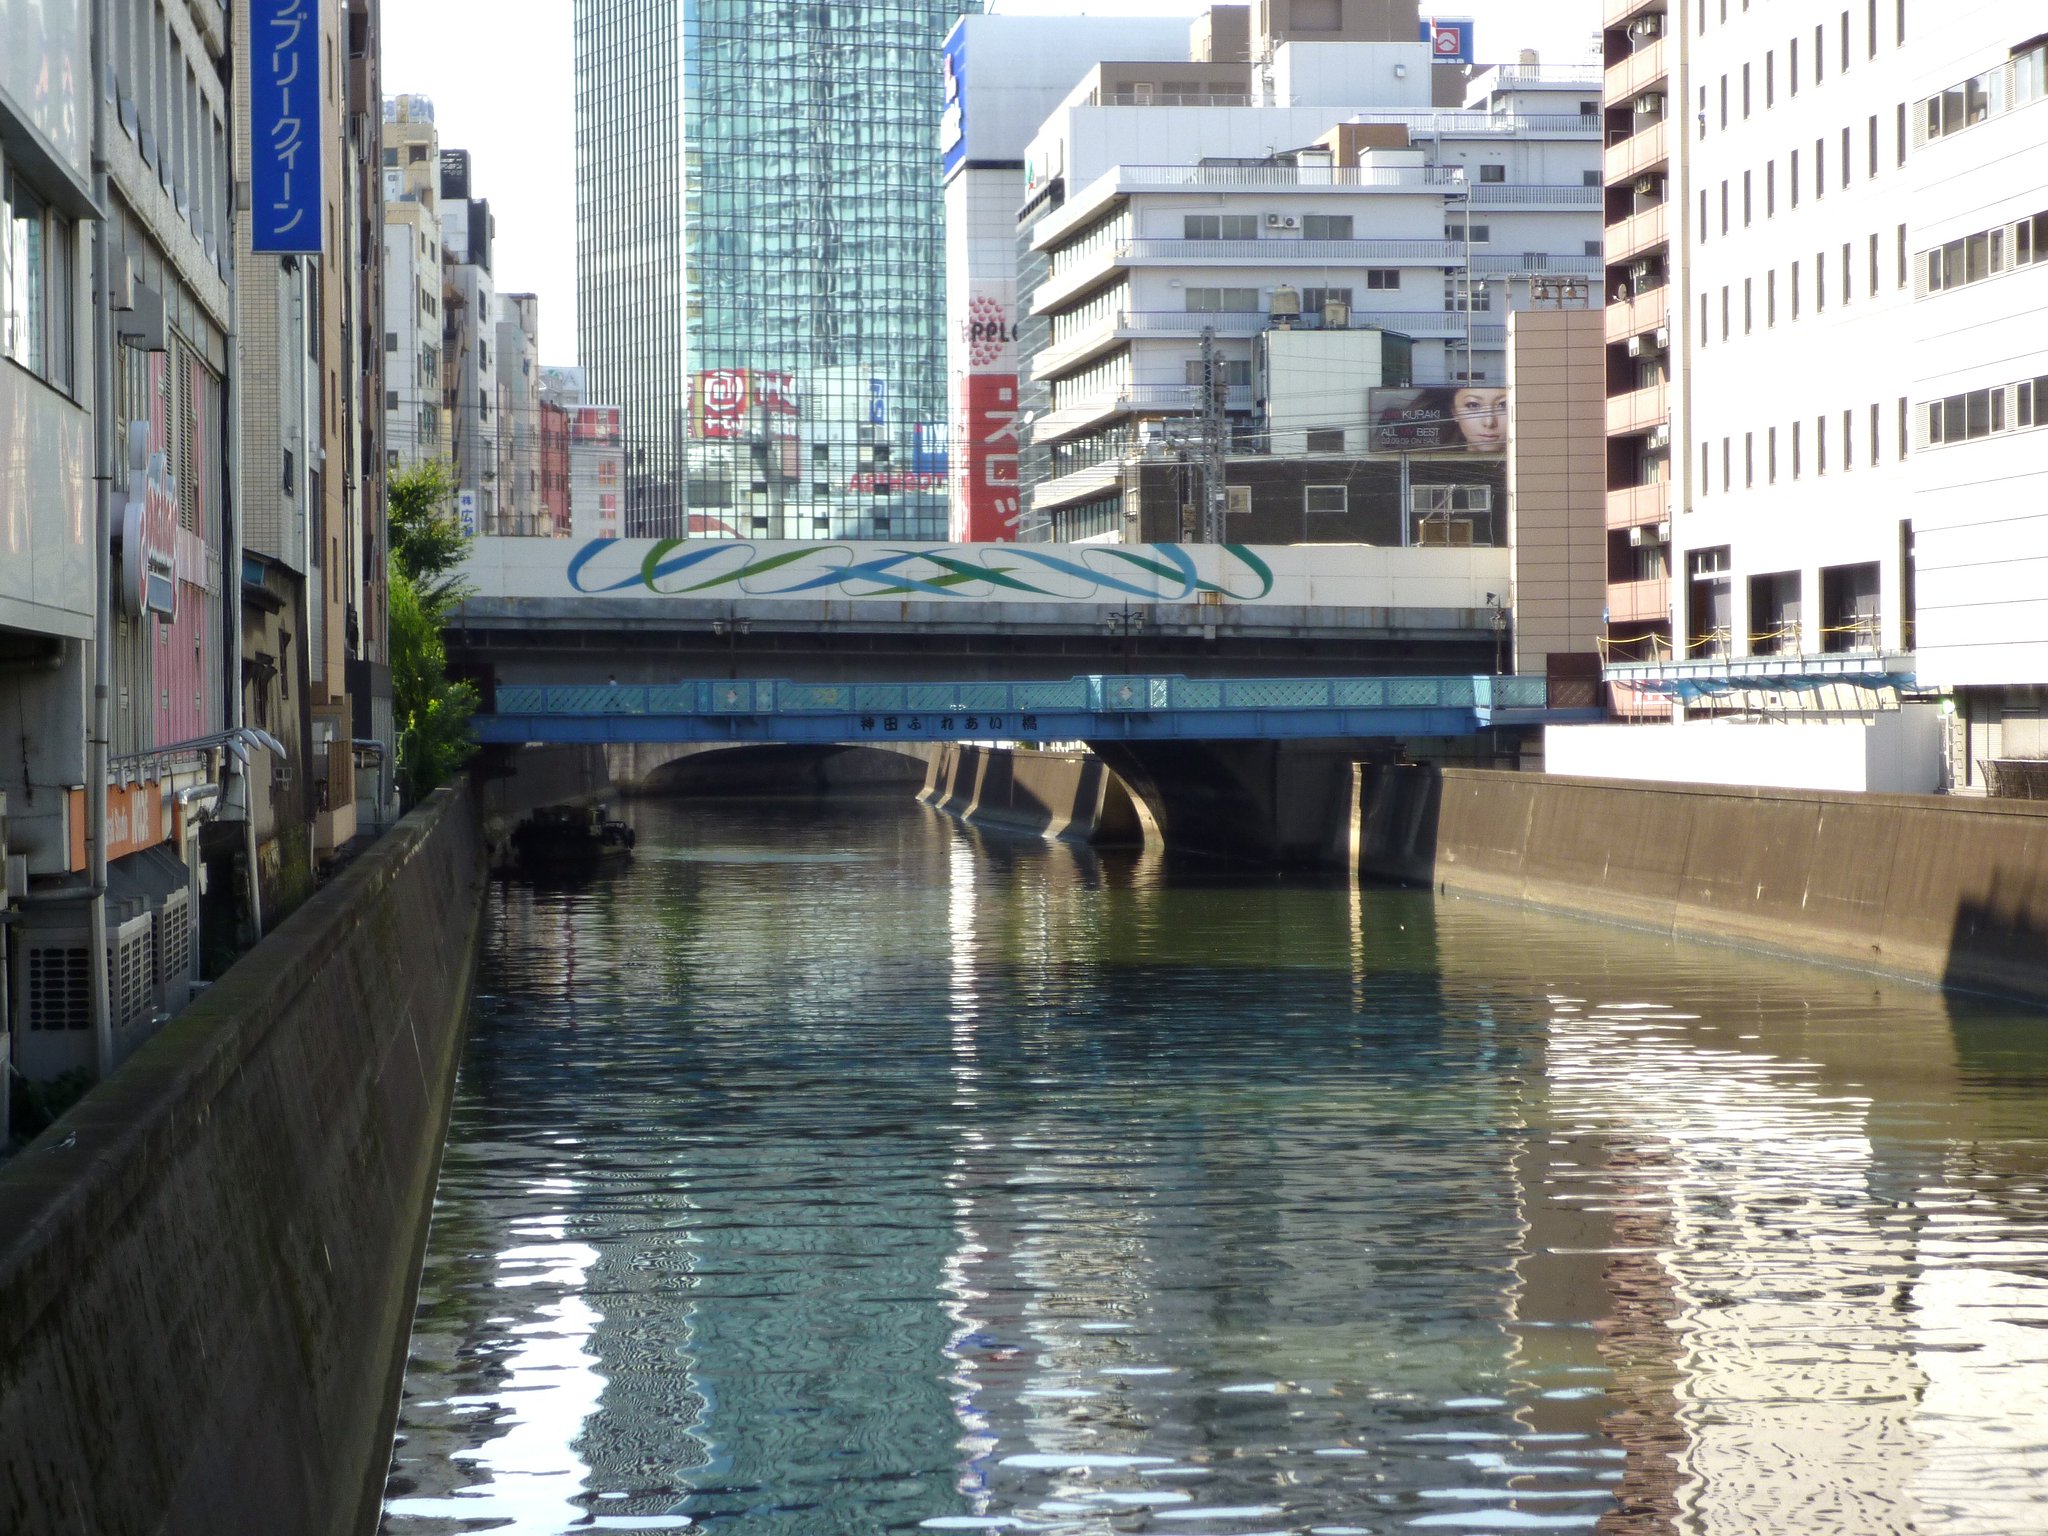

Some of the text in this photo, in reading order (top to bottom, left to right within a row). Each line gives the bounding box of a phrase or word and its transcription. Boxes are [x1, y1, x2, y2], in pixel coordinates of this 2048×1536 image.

[1402, 409, 1441, 420] KURAKI
[1381, 427, 1398, 437] ALL
[1416, 427, 1441, 437] BEST
[1411, 437, 1422, 445] ON
[1423, 437, 1441, 445] SALE
[860, 714, 1038, 732] 神田ふれあい橋
